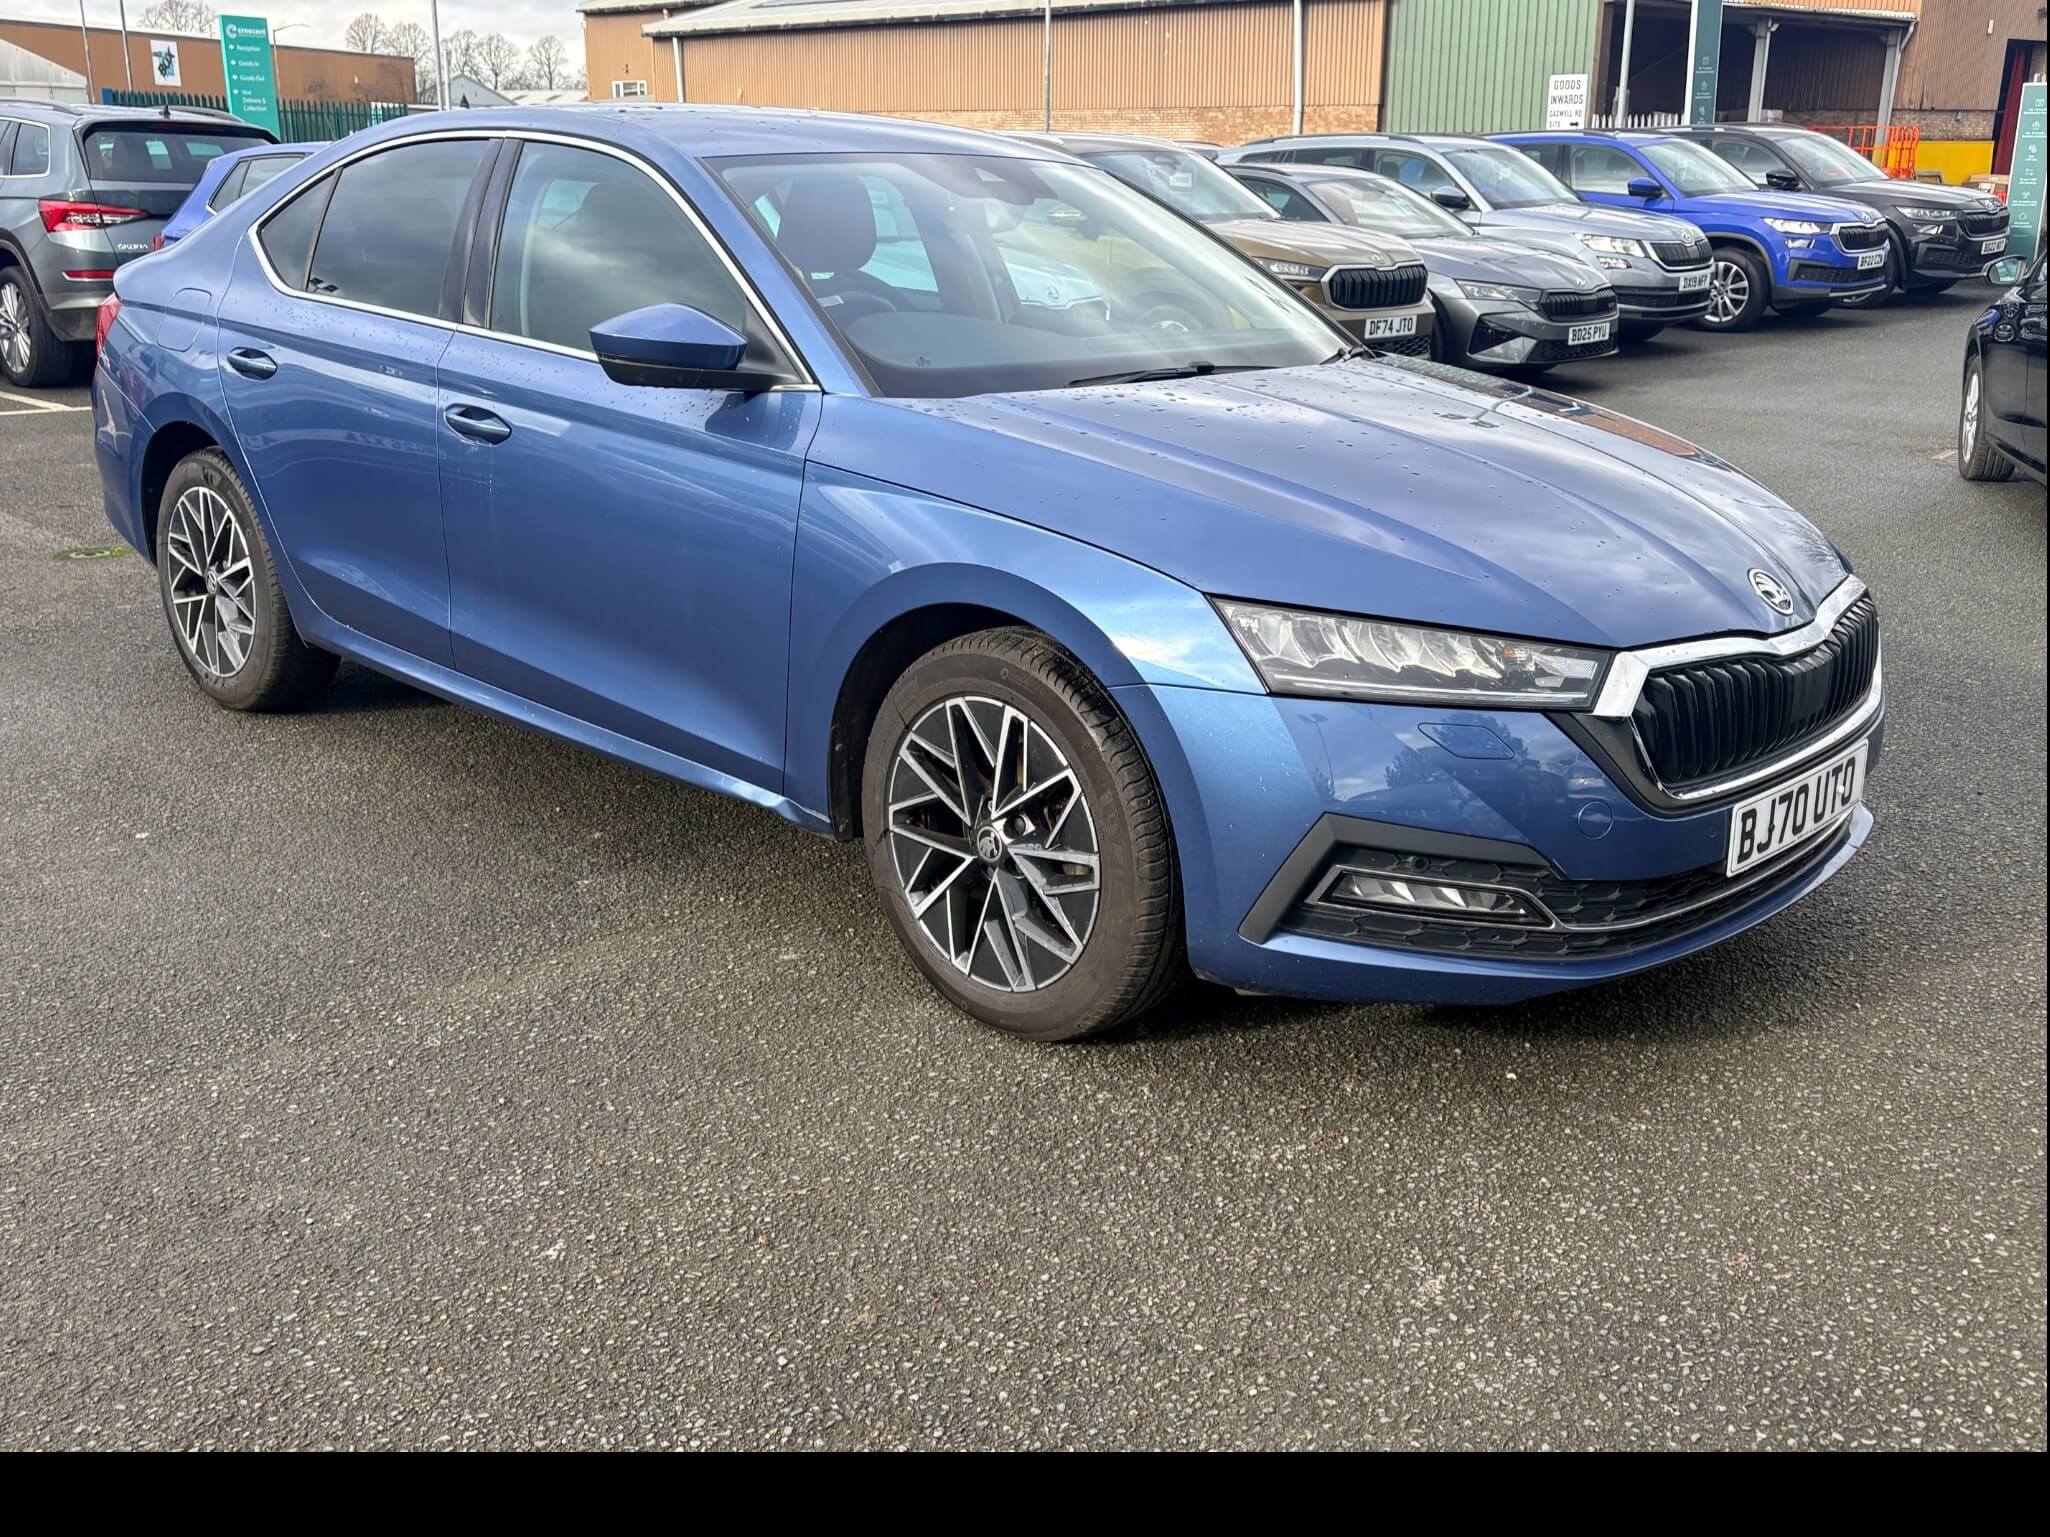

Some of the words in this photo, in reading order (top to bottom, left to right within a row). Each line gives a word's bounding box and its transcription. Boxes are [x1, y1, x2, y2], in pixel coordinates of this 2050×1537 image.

[1553, 79, 1582, 90] GOODS
[1550, 94, 1584, 105] INWARDS
[1683, 275, 1697, 289] DX19
[1369, 319, 1394, 336] DF74
[1395, 317, 1413, 333] JTO
[1571, 326, 1592, 342] BD25
[1592, 323, 1607, 340] PYU
[1737, 783, 1809, 865] BJ70
[1813, 756, 1856, 824] UTO
